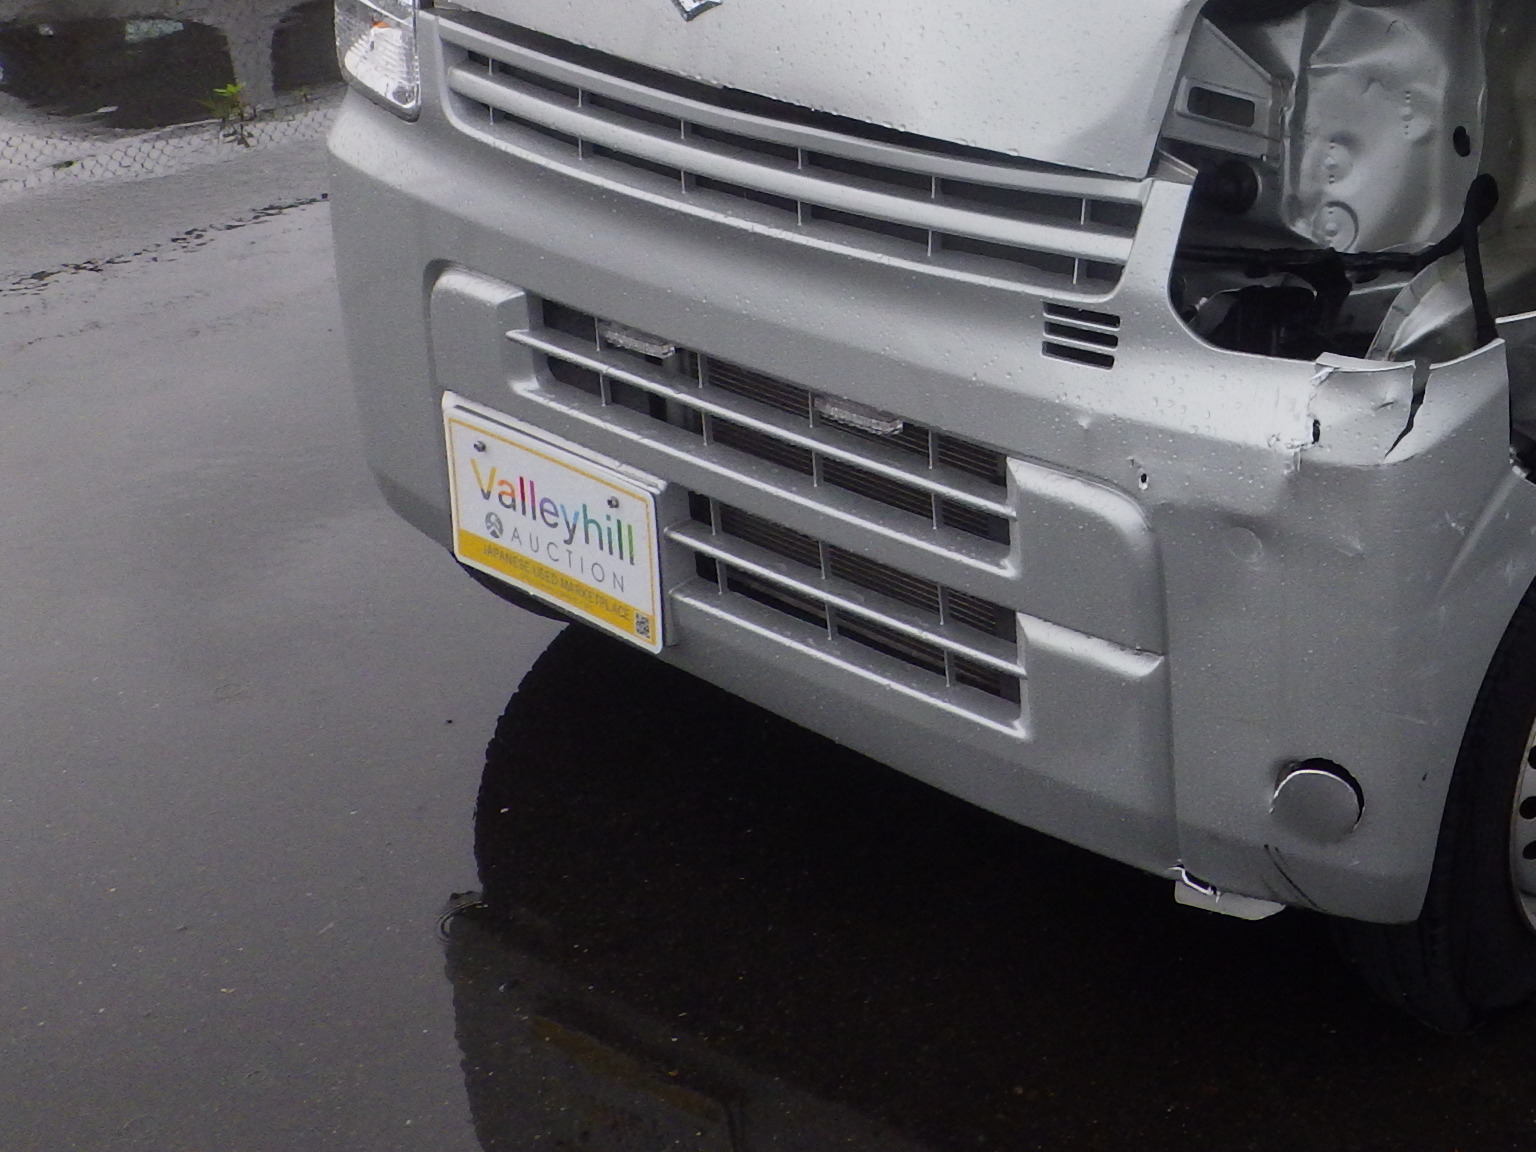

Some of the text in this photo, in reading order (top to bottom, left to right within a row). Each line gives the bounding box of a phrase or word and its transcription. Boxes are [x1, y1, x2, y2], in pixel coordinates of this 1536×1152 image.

[470, 458, 635, 565] Valleyhill
[483, 543, 530, 573] JAPANESE
[533, 566, 557, 586] USED
[560, 577, 632, 621] MARKETPLACE
[511, 527, 625, 592] AUCTION
